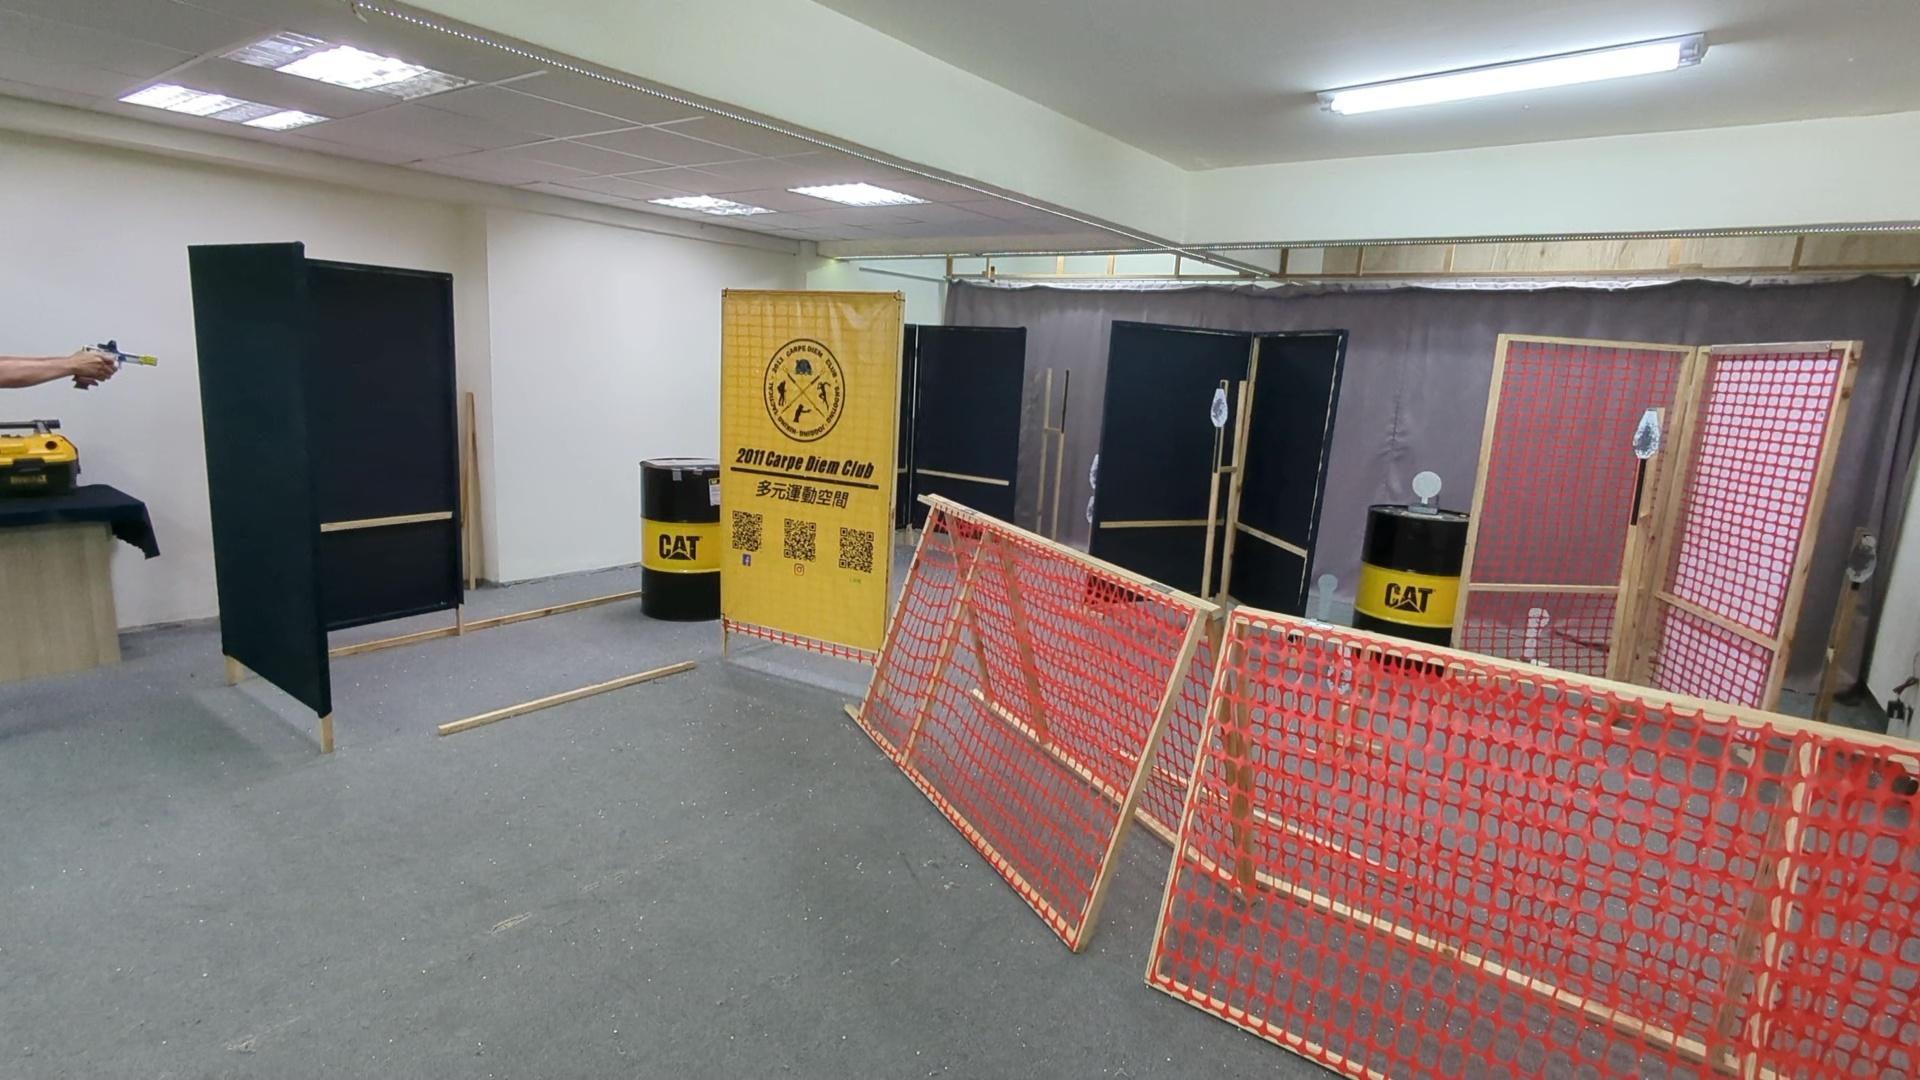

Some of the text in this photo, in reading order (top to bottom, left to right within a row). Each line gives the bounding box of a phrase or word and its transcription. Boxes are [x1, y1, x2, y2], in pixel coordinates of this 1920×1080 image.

[786, 345, 806, 357] CARPE
[807, 345, 824, 358] DIEM
[736, 448, 875, 479] 2011 Carpe Diem Club
[756, 480, 849, 509] 多元運動空間
[658, 534, 700, 560] CAT
[1384, 582, 1433, 614] CAT
